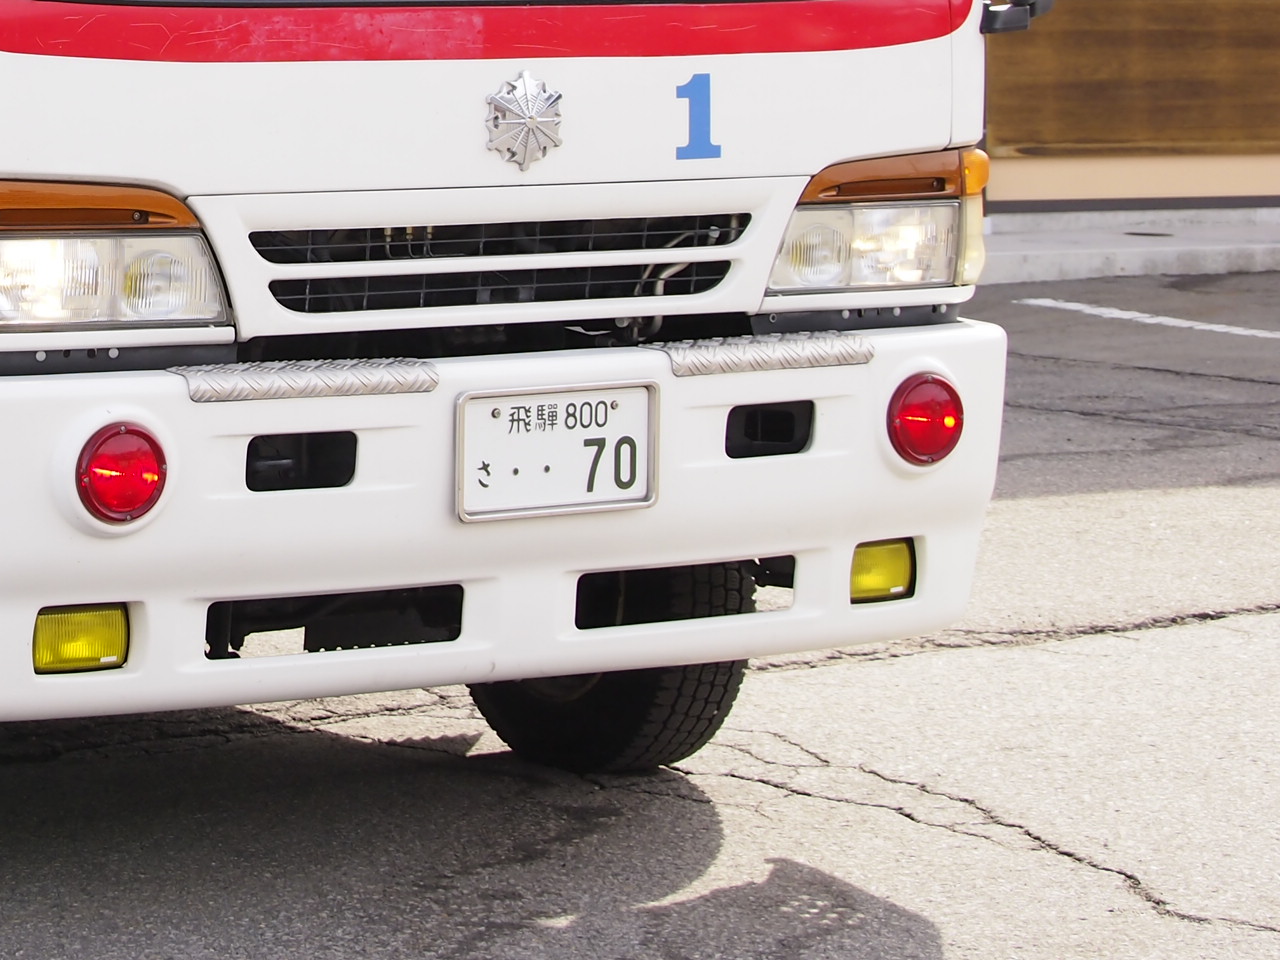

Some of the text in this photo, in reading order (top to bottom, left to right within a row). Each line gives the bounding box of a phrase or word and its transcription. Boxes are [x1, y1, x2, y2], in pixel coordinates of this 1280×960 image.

[676, 73, 722, 161] 1
[564, 400, 608, 430] 800
[583, 435, 637, 493] 70
